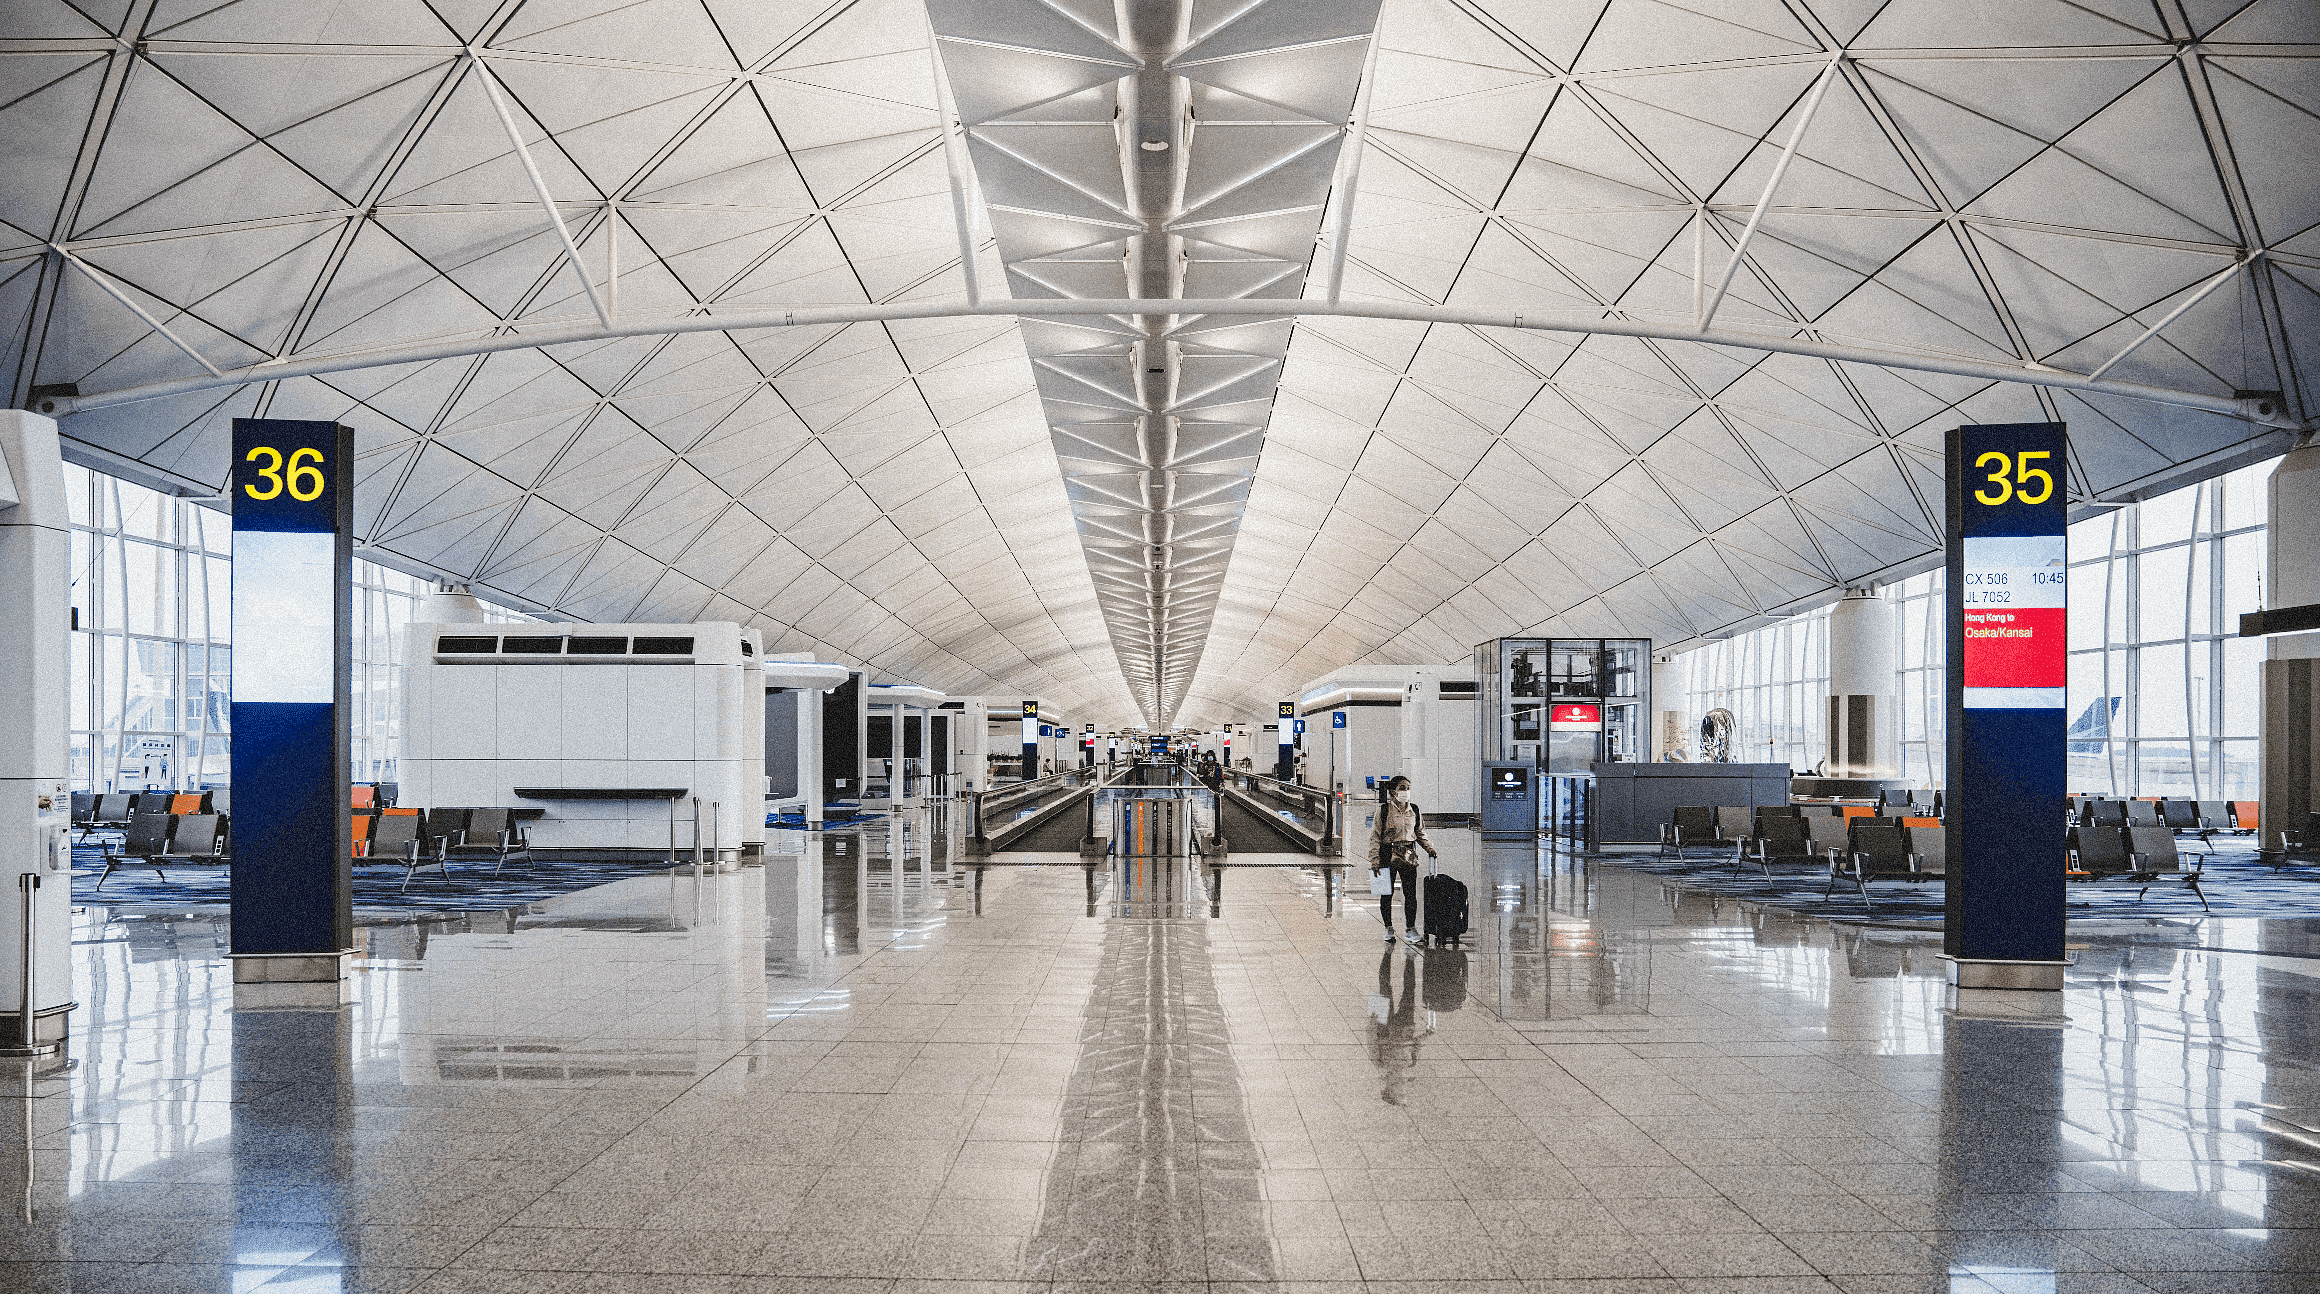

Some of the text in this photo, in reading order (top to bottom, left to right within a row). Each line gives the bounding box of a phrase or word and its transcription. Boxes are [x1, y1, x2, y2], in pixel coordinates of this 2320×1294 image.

[244, 446, 325, 502] 36
[1974, 450, 2054, 506] 35
[1965, 572, 2008, 585] CX 506
[2032, 572, 2064, 585] 10:45
[1965, 591, 2011, 603] JL 7052
[1965, 613, 2016, 624] Hong Kong to
[1965, 627, 2033, 638] Osaka/Kansai
[1024, 704, 1037, 714] 34
[1280, 705, 1293, 715] 33
